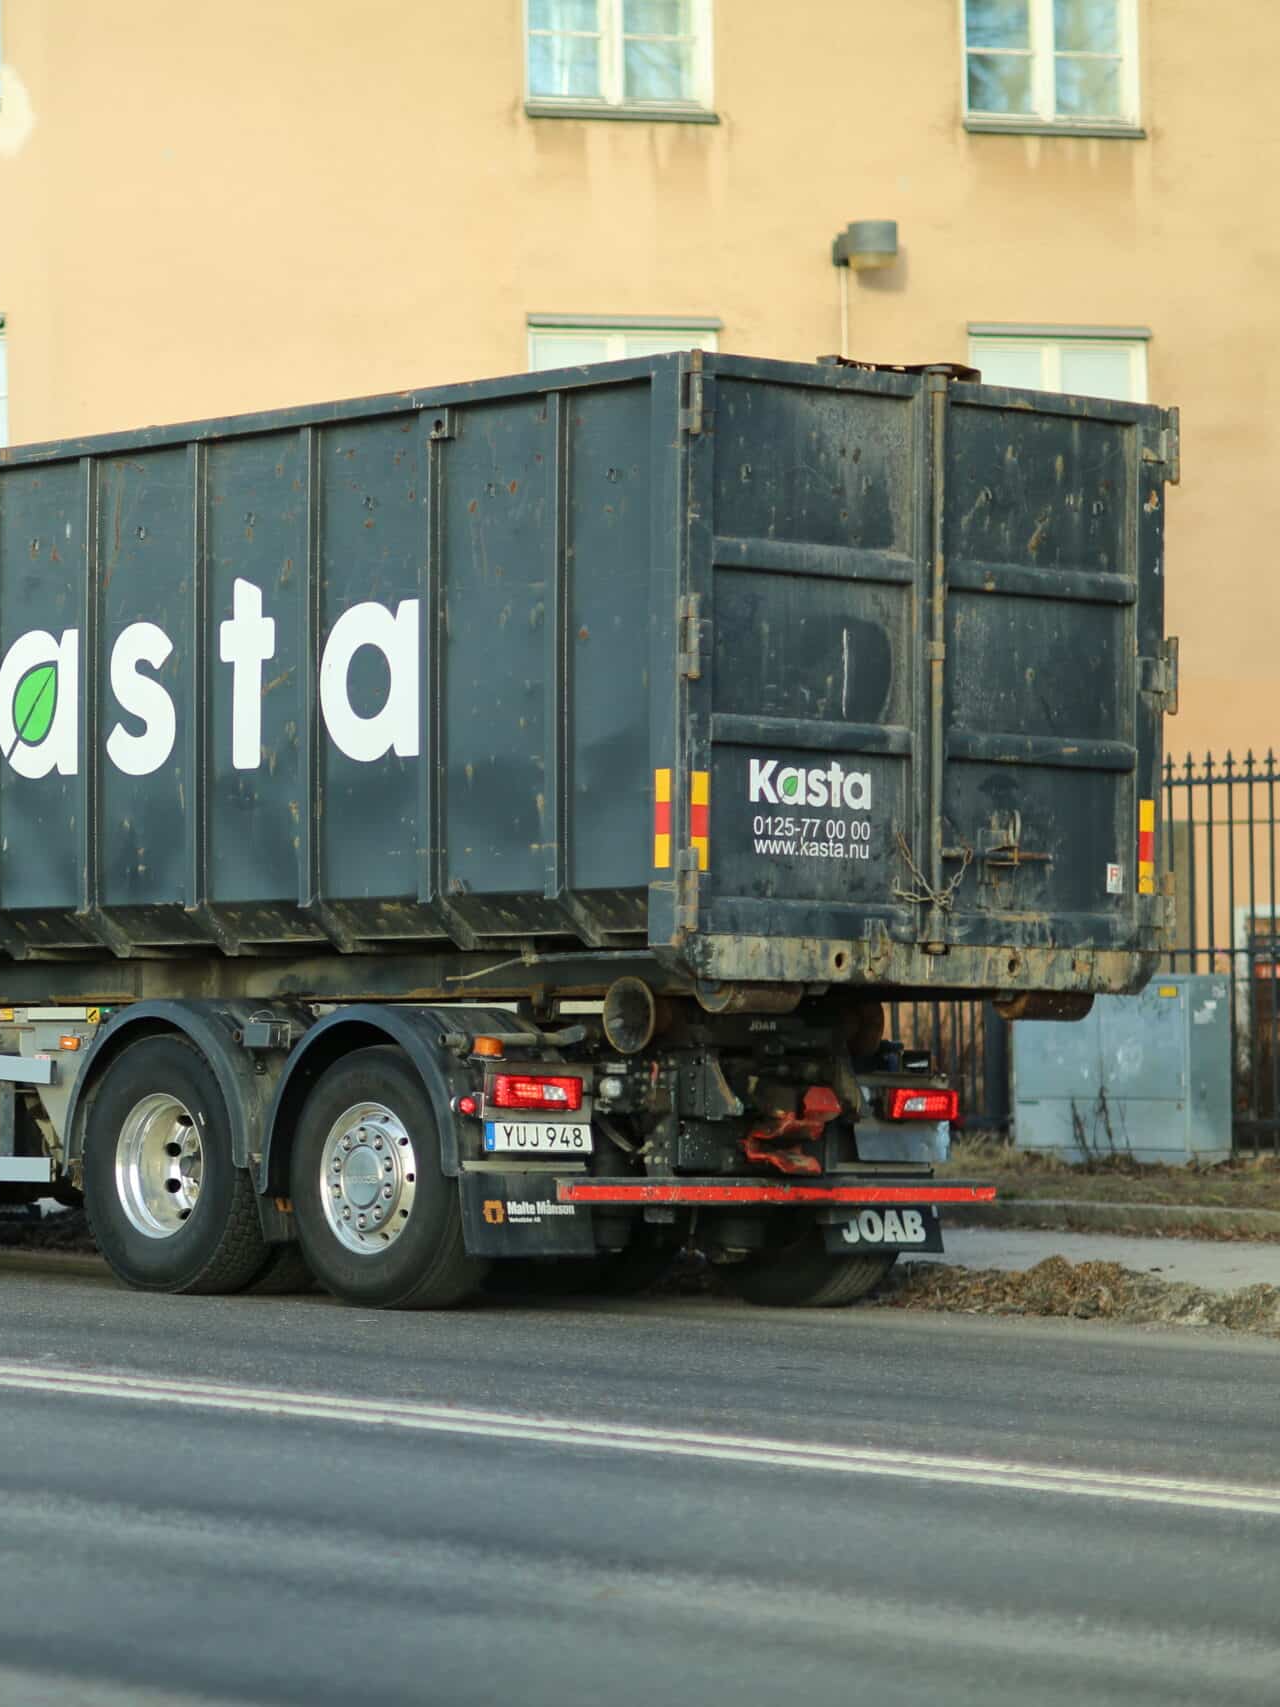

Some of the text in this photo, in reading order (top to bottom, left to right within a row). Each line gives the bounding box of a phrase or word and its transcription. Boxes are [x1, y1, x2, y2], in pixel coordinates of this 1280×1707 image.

[749, 759, 872, 810] Kasta
[753, 815, 871, 841] 0125-77 00 00
[754, 837, 870, 859] www.kasta.nu
[503, 1125, 583, 1148] YUJ 948
[506, 1200, 536, 1215] Malte
[841, 1209, 926, 1244] JOAB
